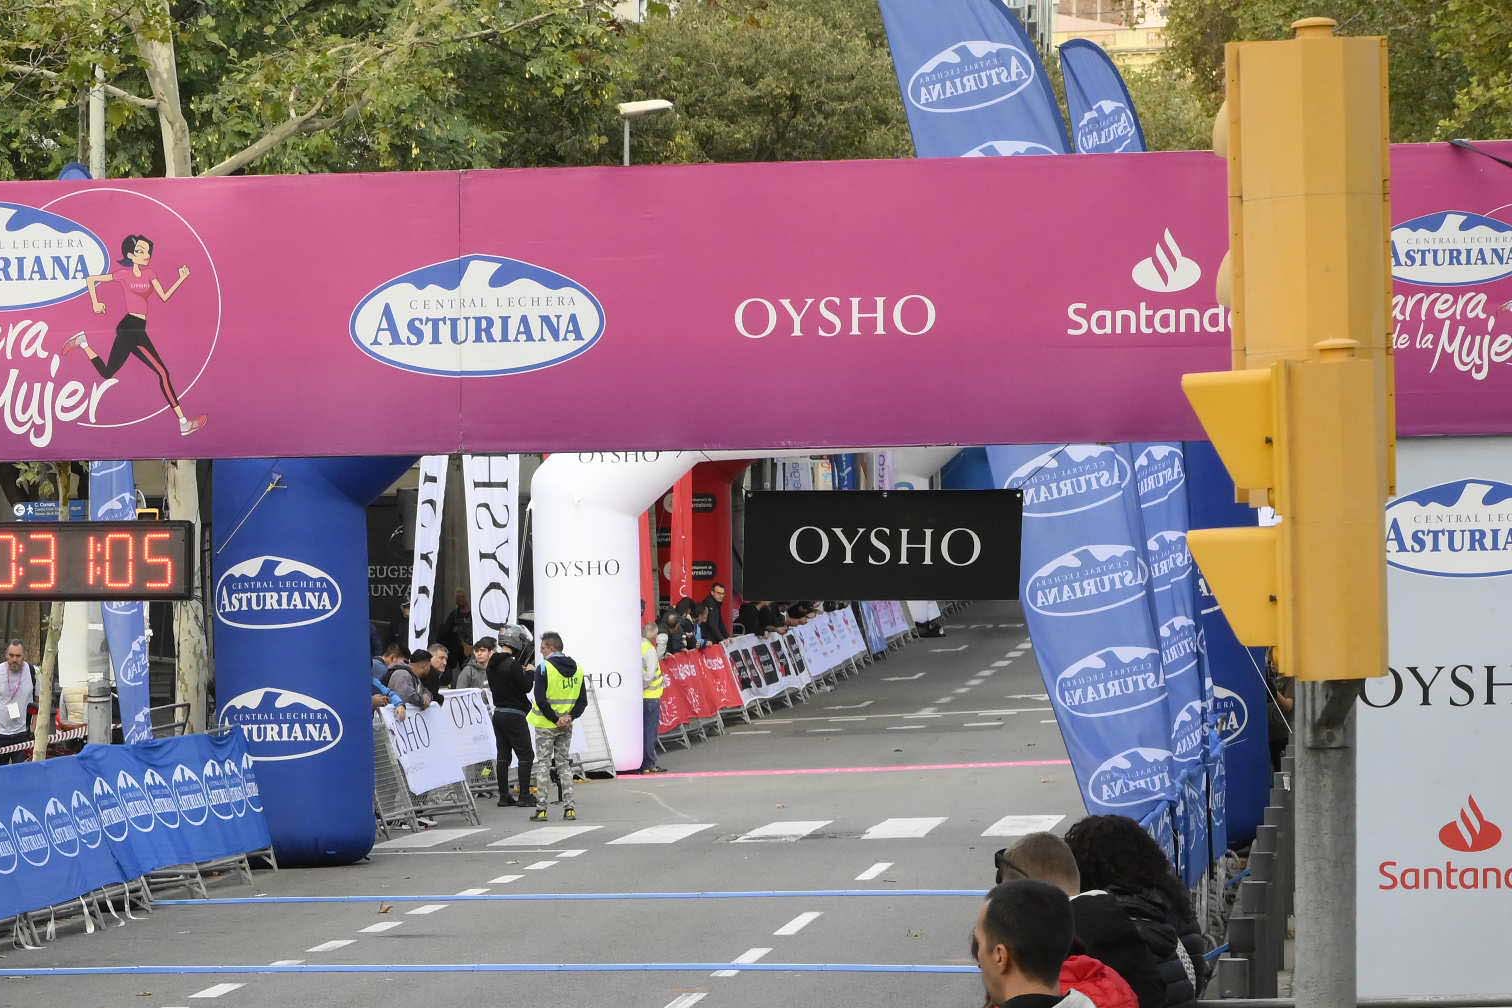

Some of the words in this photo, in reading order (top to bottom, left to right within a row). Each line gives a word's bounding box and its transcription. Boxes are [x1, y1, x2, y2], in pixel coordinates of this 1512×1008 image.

[13, 238, 84, 249] LECHERA
[410, 298, 488, 310] CENTRAL
[496, 296, 576, 307] LECHERA
[734, 294, 936, 338] OYSHO
[1392, 292, 1488, 321] arrera
[370, 302, 585, 346] ASTURIANA
[1416, 322, 1434, 349] la
[1429, 316, 1512, 381] Muje
[1414, 513, 1480, 523] CENTRAL
[789, 526, 982, 566] OYSHO
[545, 559, 620, 578] OYSHO
[232, 580, 275, 589] CENTRAL
[279, 580, 328, 588] LECHERA
[219, 585, 332, 613] ASTURIANA
[1360, 664, 1512, 708] OYSH
[279, 712, 328, 720] LECHERA
